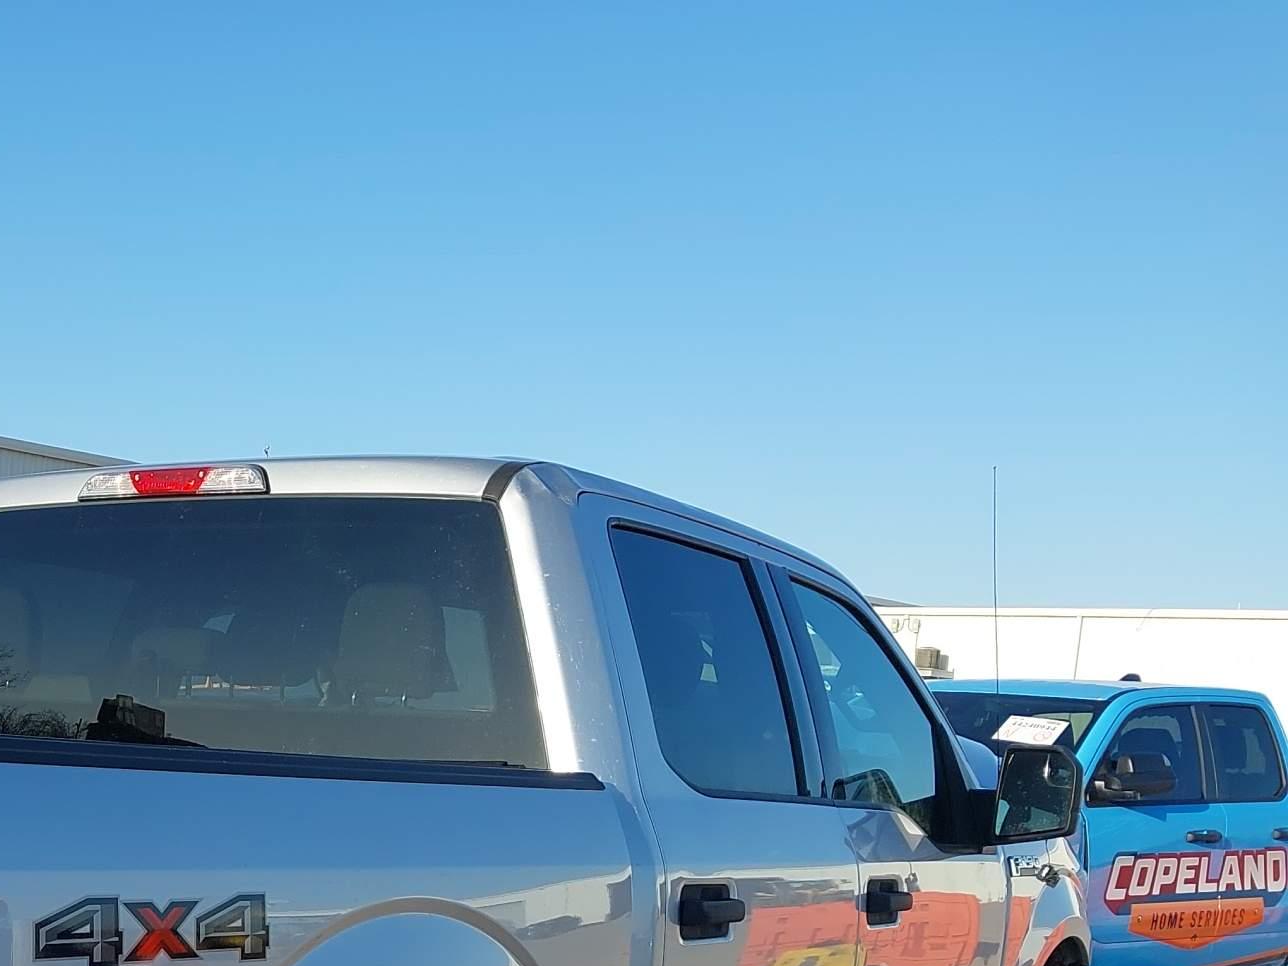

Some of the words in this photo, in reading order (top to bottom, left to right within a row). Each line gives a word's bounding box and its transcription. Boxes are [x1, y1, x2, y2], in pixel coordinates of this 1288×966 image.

[1105, 849, 1287, 901] COPELAND
[1150, 912, 1185, 931] HOME
[1190, 908, 1246, 928] SERVICES
